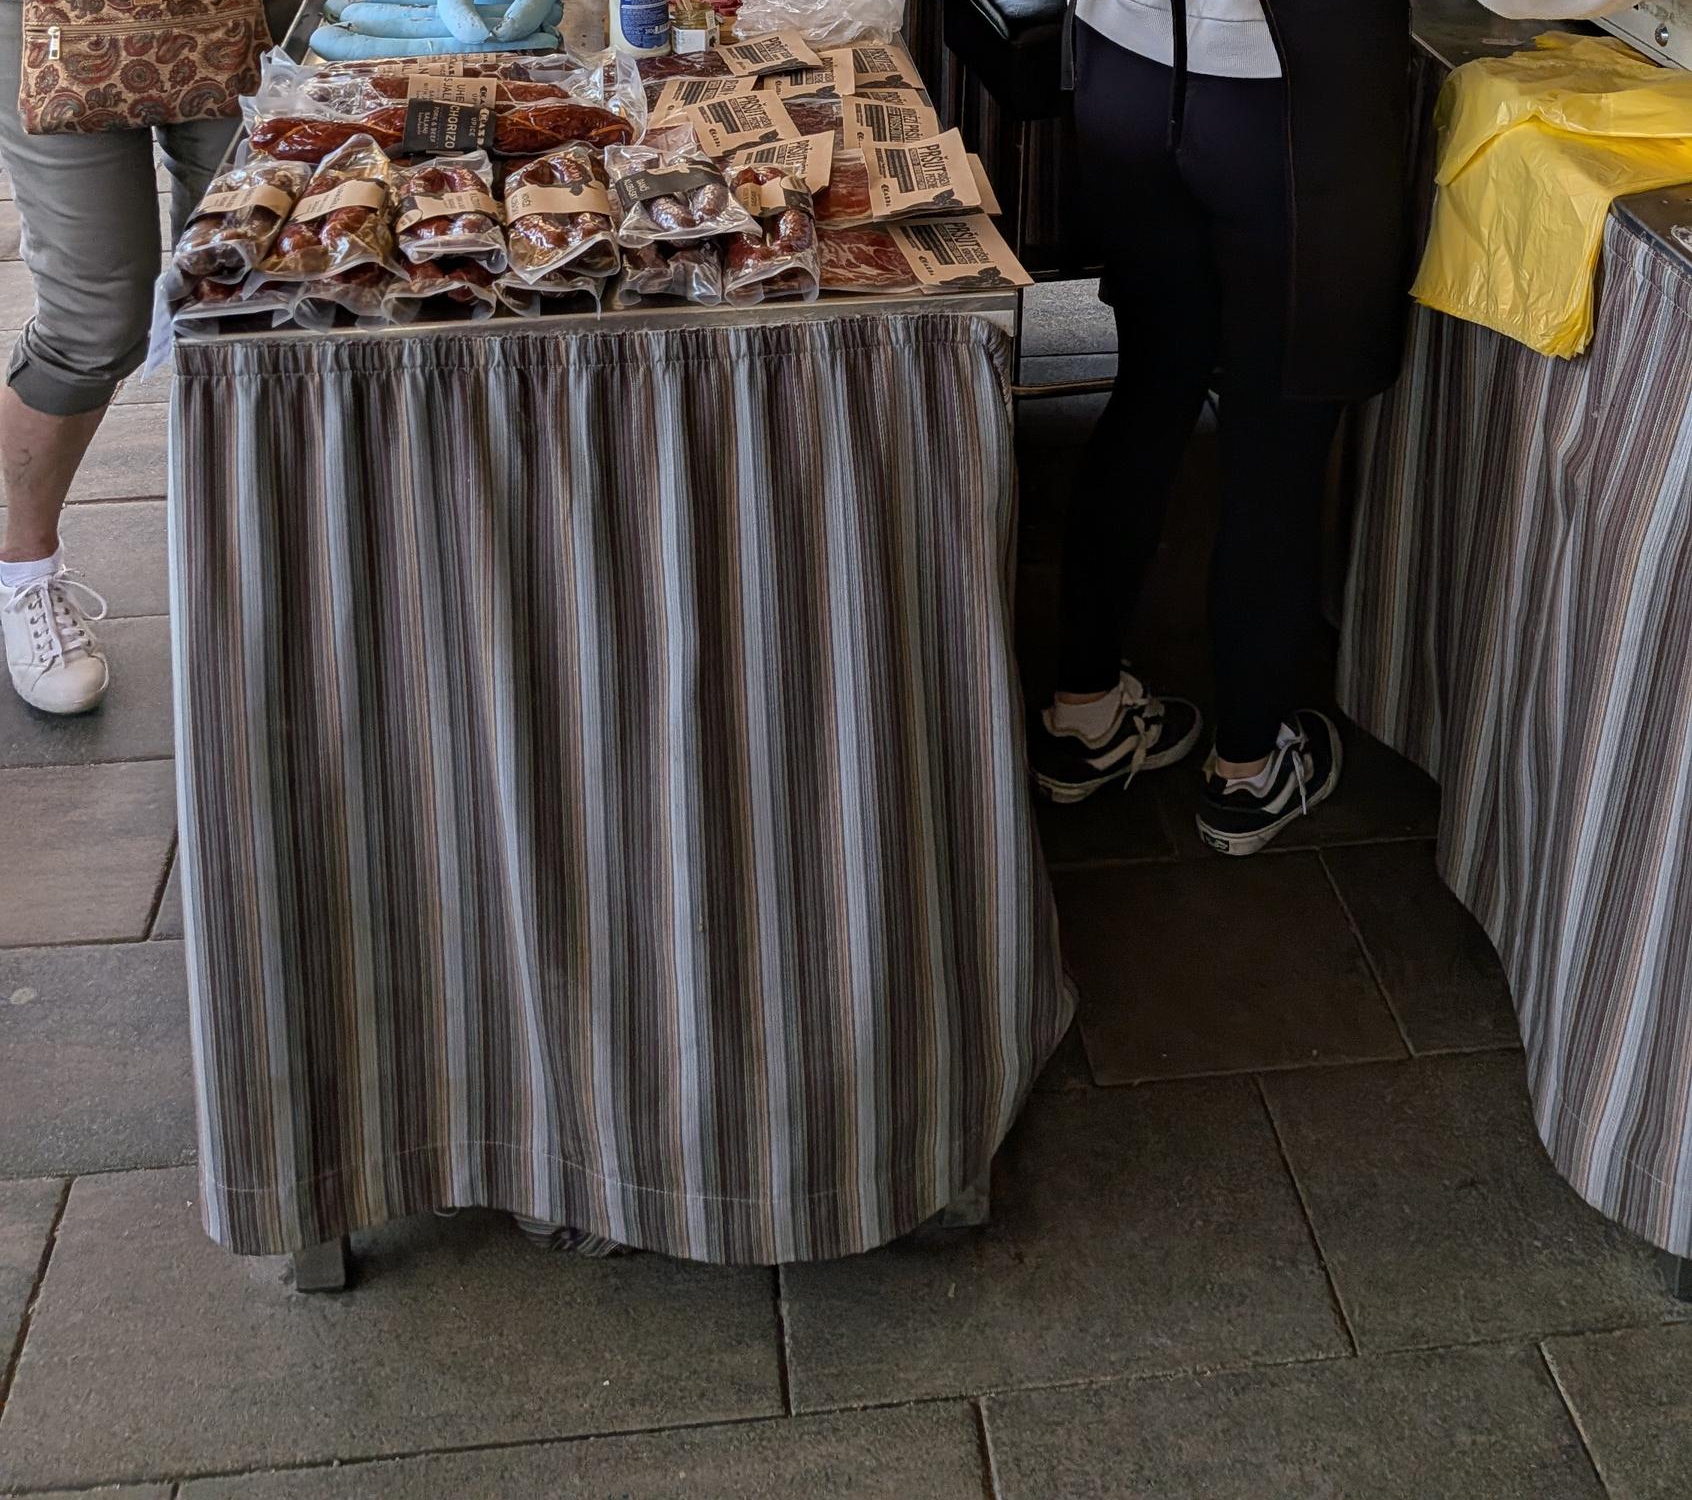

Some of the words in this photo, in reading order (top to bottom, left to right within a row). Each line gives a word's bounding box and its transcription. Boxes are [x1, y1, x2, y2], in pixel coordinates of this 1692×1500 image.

[739, 94, 767, 116] PRŠUT
[445, 105, 460, 149] CHORIZO
[905, 124, 923, 143] PRŠU
[918, 143, 949, 175] PRŠUT
[945, 222, 979, 251] PRŠUT
